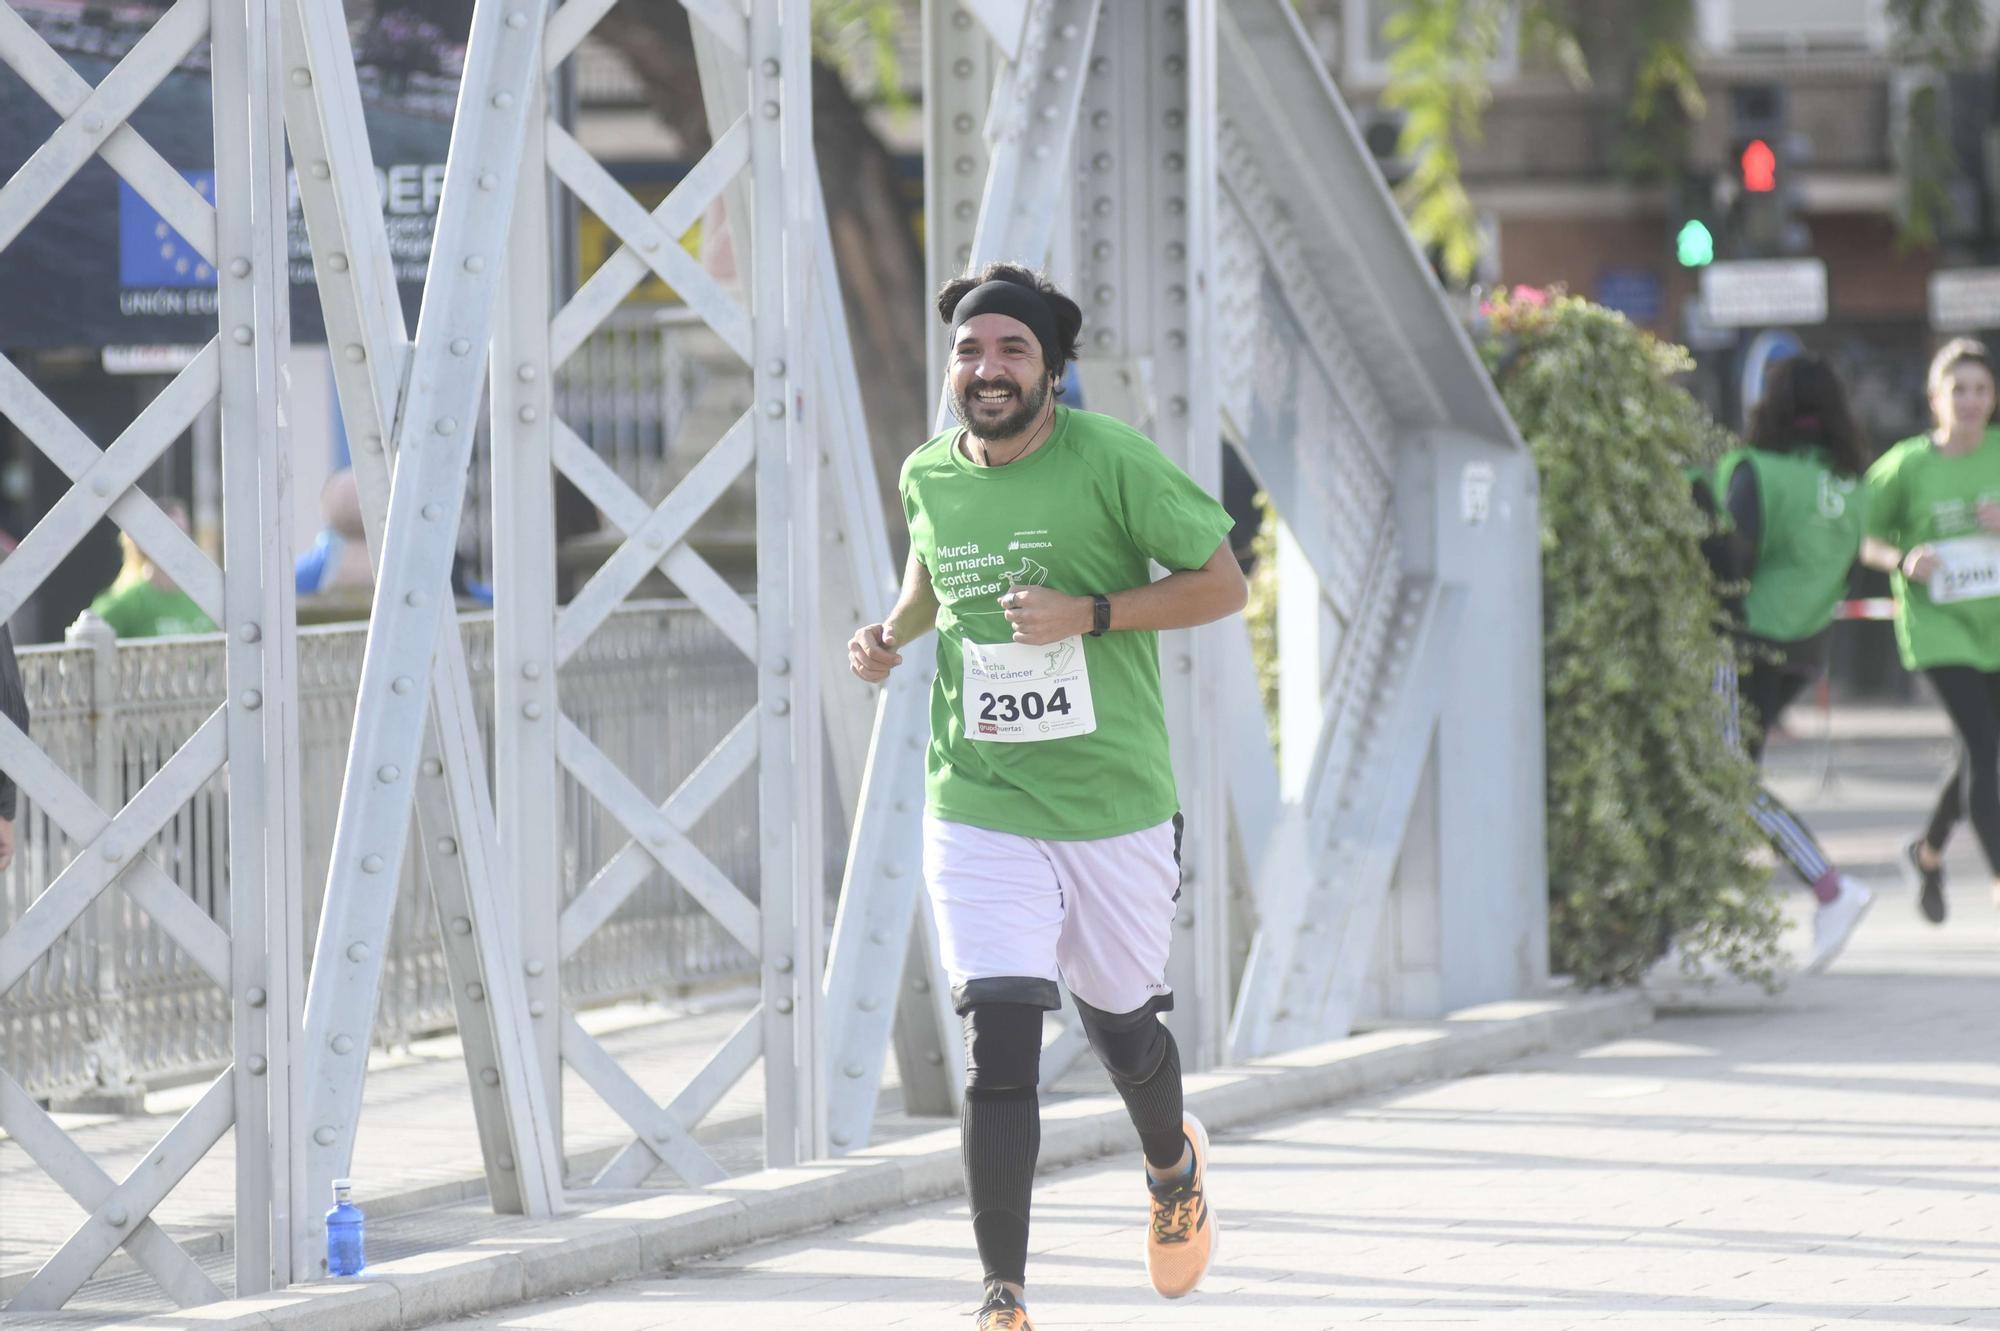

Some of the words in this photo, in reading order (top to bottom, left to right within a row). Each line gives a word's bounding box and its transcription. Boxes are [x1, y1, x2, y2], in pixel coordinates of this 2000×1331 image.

[120, 287, 184, 315] UNIÓN
[187, 289, 218, 316] EU
[937, 542, 979, 559] Murcia
[1020, 541, 1053, 549] IBERDROLA
[939, 562, 952, 573] en
[956, 554, 1005, 570] marcha
[942, 572, 981, 587] contra
[946, 588, 956, 600] el
[958, 581, 1002, 598] cáncer
[990, 671, 999, 680] el
[1000, 669, 1033, 680] cáncer
[979, 686, 1072, 722] 2304
